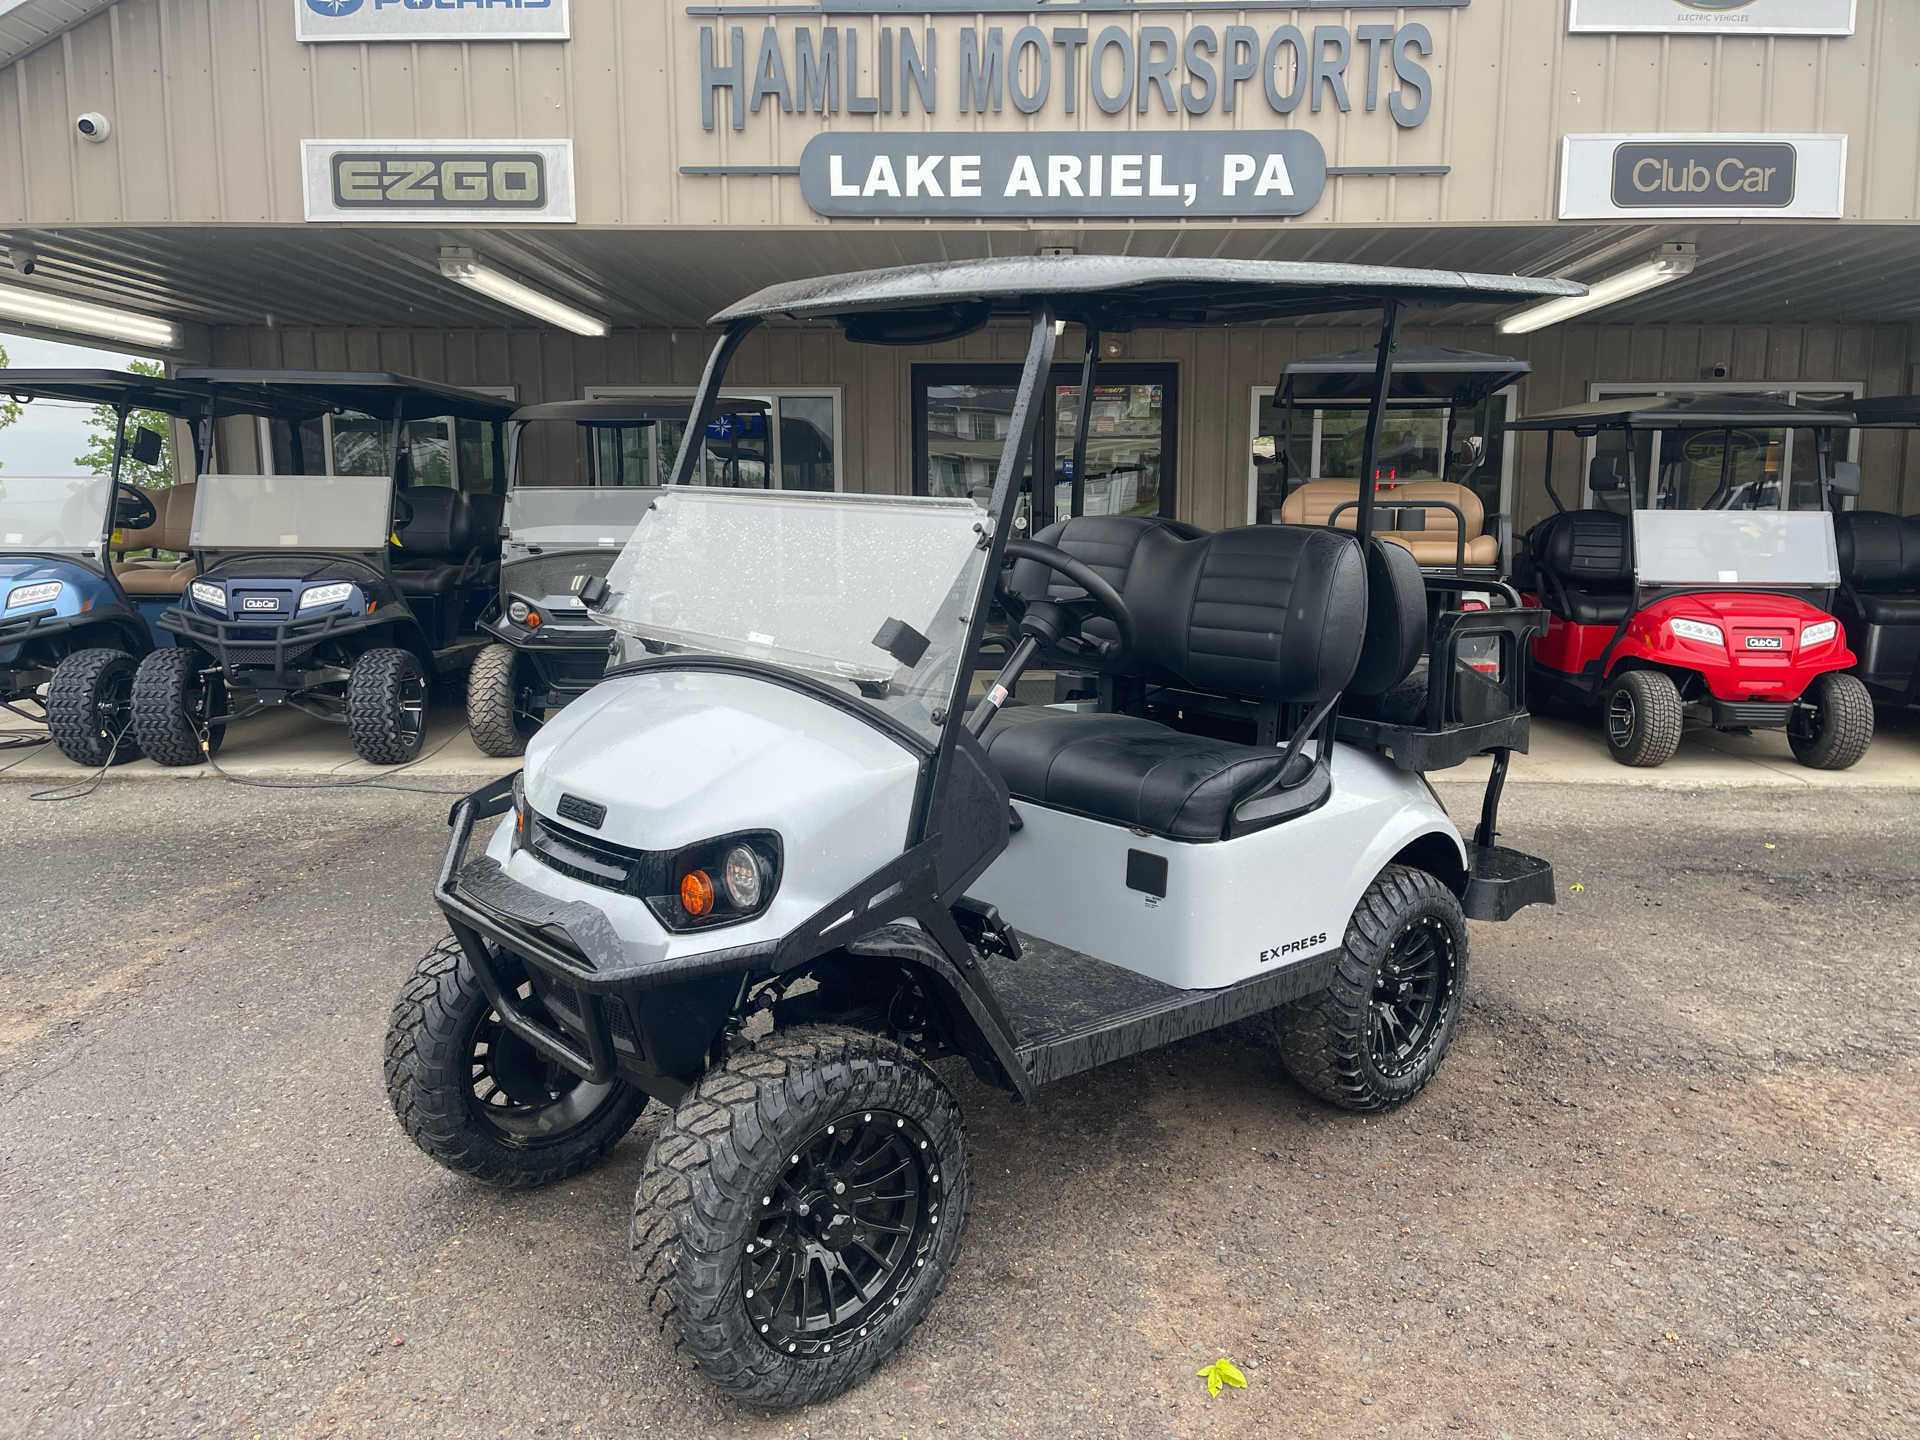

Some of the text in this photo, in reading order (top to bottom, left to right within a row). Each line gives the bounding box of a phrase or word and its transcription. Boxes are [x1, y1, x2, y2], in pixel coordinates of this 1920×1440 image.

[1677, 13, 1749, 22] ELECTRIC VEHICLES
[700, 23, 1433, 130] HAMLIN MOTORSPORTS
[829, 154, 1294, 207] LAKE ARIEL, PA
[1633, 158, 1776, 192] Club Car
[247, 600, 275, 608] Club Car
[1750, 638, 1778, 646] Club Car
[1260, 932, 1327, 963] EXPRESS
